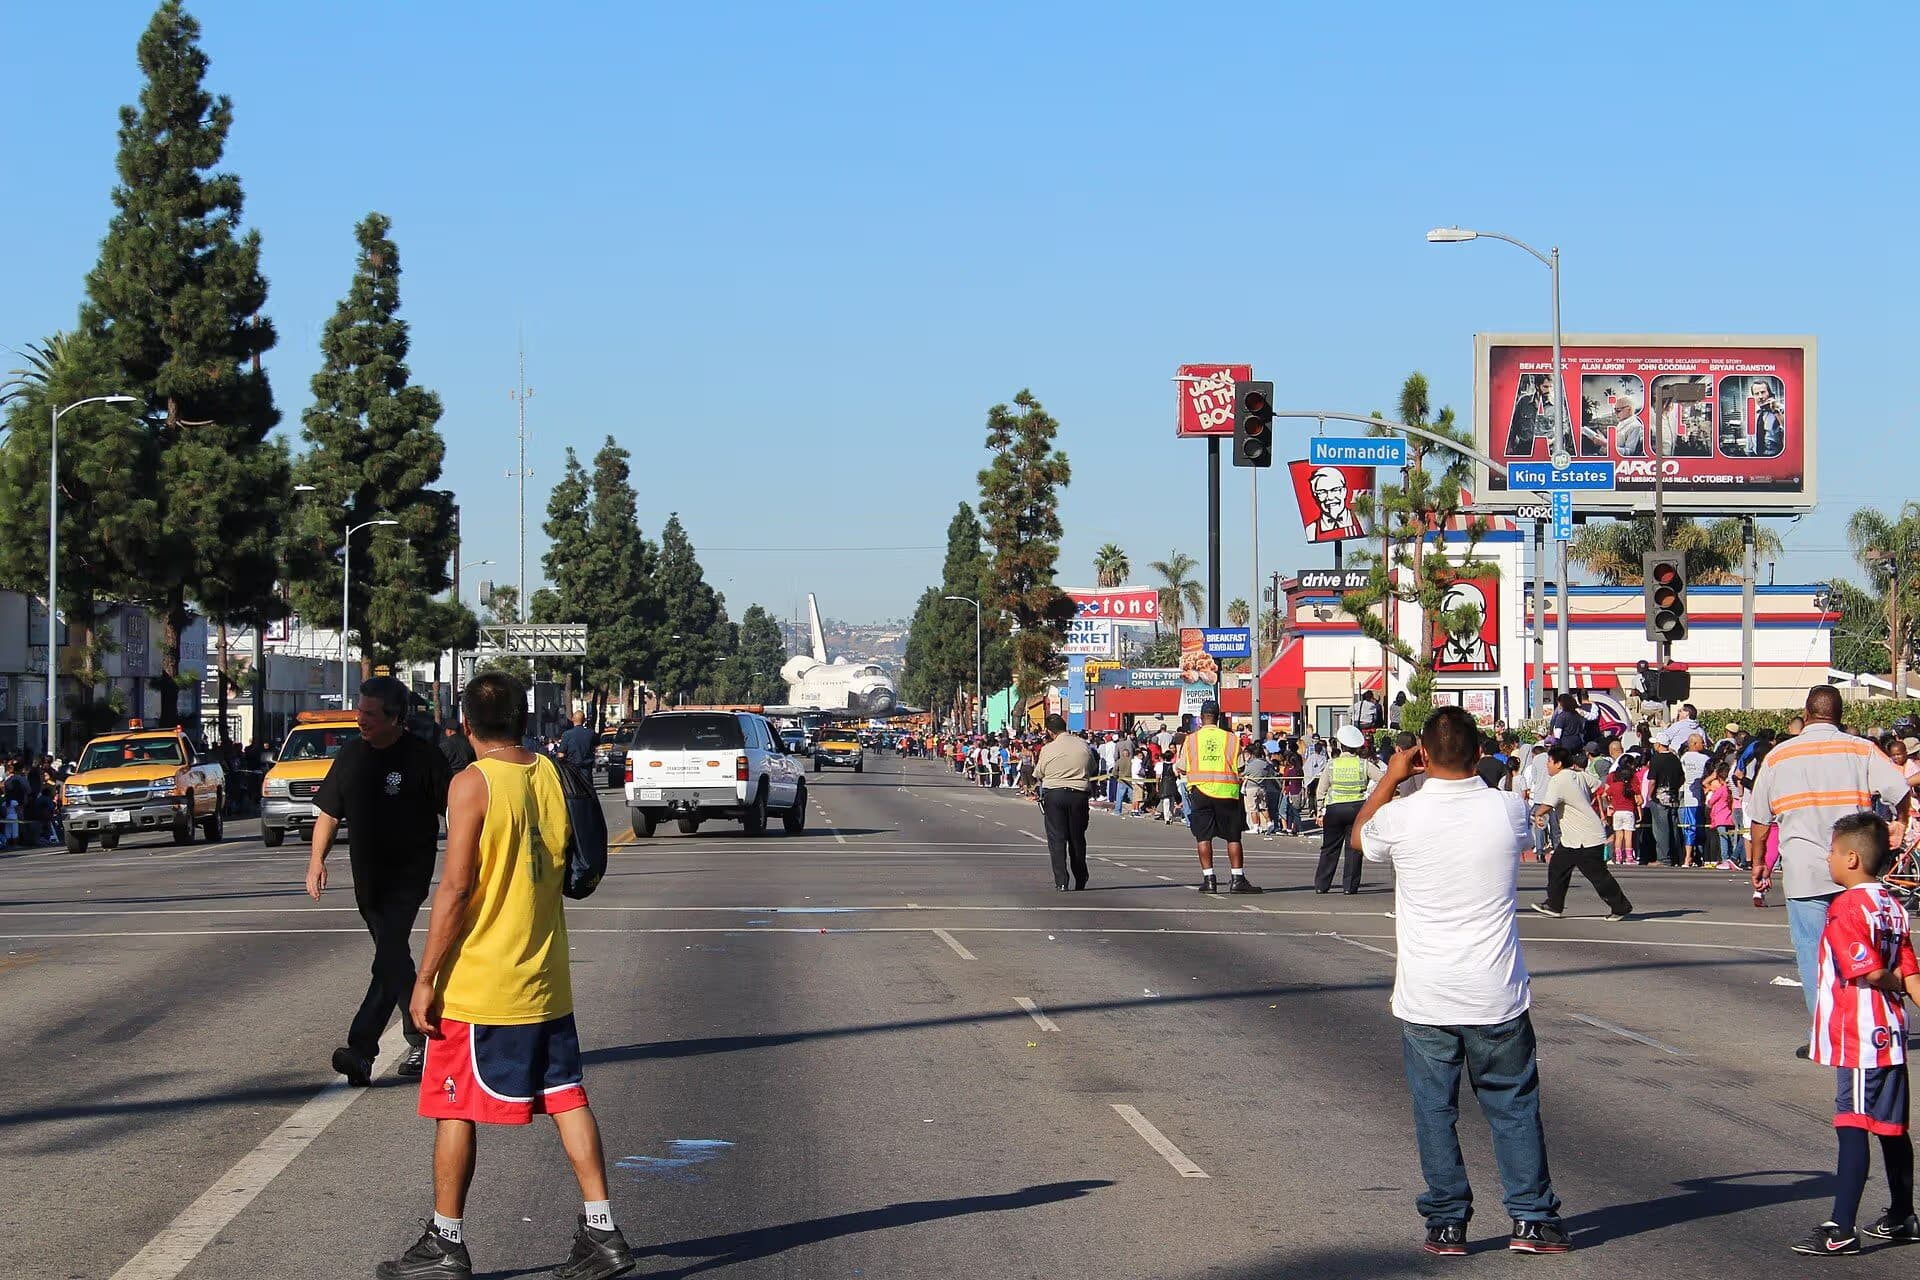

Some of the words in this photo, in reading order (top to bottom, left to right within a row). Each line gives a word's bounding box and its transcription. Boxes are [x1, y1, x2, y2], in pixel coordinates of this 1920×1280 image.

[1189, 368, 1235, 397] JACK
[1212, 383, 1236, 405] TH
[1198, 404, 1235, 430] BOX
[1503, 373, 1787, 459] ARGO
[1316, 443, 1399, 459] Normandie
[1615, 460, 1680, 476] ARGO
[1515, 470, 1546, 485] King
[1551, 470, 1607, 482] Estates
[1692, 475, 1734, 483] OCTOBER
[1734, 475, 1744, 484] 12
[1302, 572, 1341, 587] drive
[1345, 572, 1370, 587] thr
[1102, 597, 1155, 615] tone
[1206, 633, 1248, 643] BREAKFAST
[1208, 643, 1226, 652] SERVED
[1131, 672, 1181, 680] DRIVE-THR
[1186, 690, 1213, 698] POPCORN
[1851, 958, 1874, 972] pepsi
[1871, 1025, 1903, 1049] Ch
